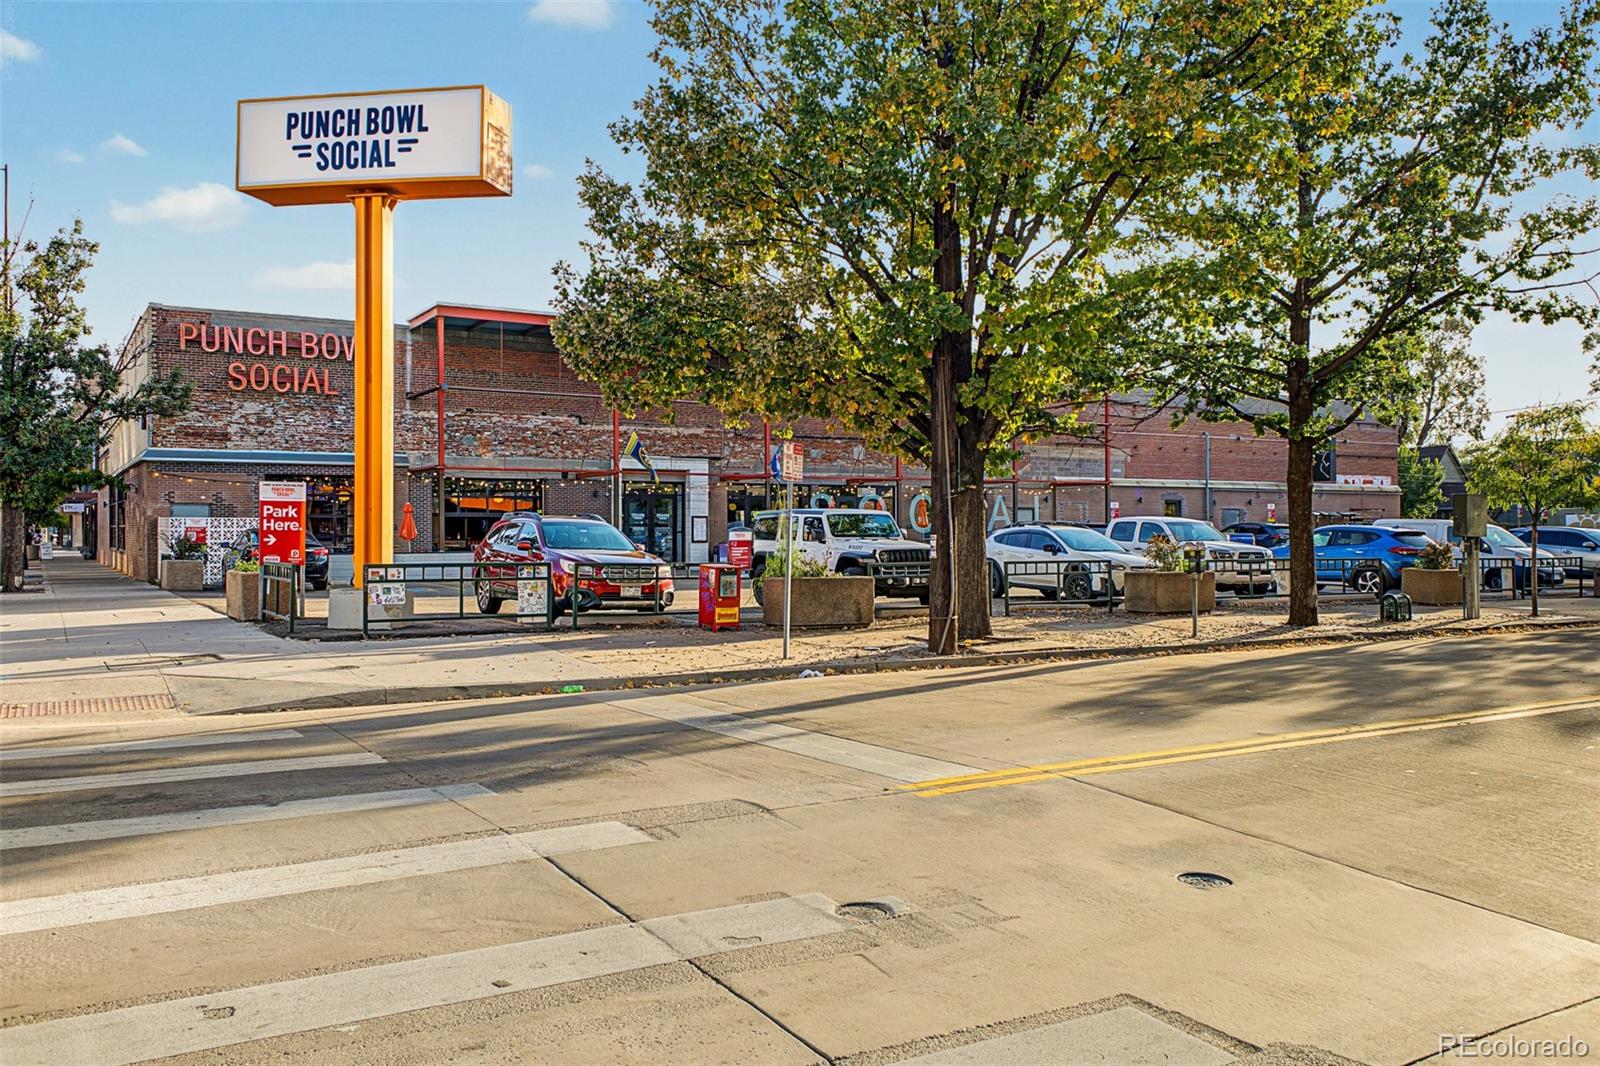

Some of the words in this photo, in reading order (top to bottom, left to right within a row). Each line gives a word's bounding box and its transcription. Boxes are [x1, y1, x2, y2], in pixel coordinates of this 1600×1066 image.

[286, 108, 361, 141] PUNCH
[366, 104, 429, 136] BOWL
[316, 139, 396, 171] SOCIAL
[179, 322, 287, 356] PUNCH
[228, 361, 340, 396] SOCIAL
[263, 505, 298, 518] Park
[263, 518, 303, 531] Here.
